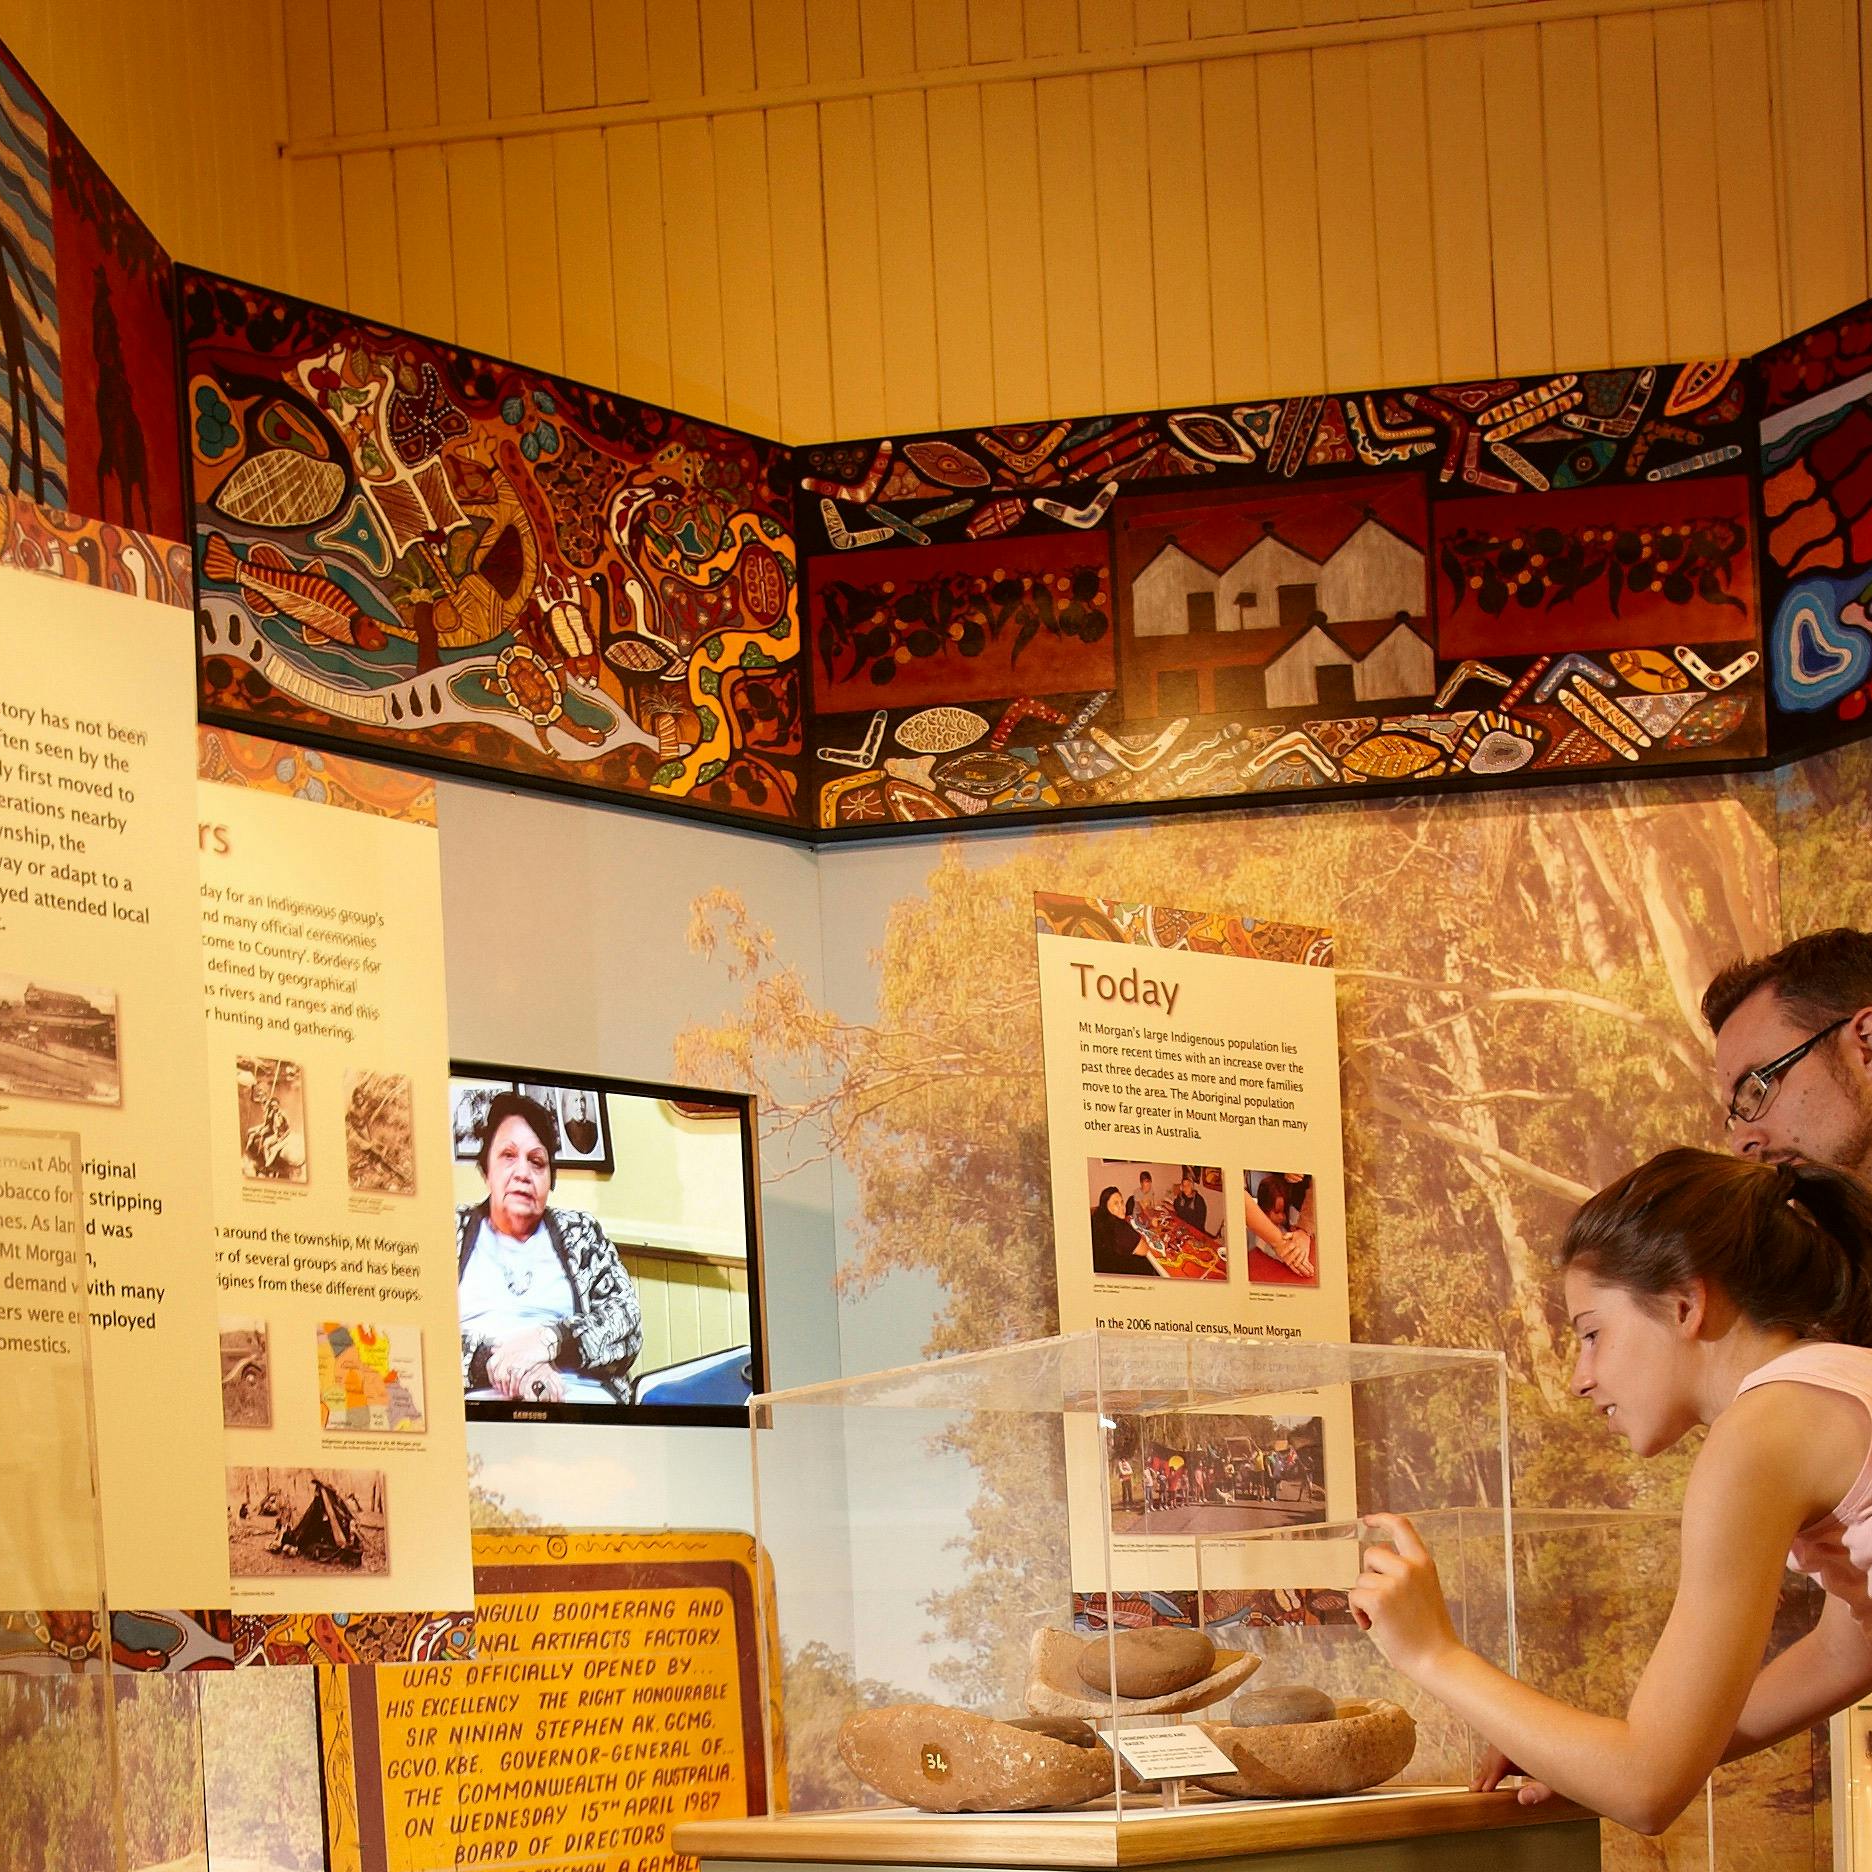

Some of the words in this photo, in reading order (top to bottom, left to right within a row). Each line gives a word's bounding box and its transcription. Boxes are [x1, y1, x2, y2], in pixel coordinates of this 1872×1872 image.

[41, 708, 69, 729] has
[76, 721, 101, 737] not
[108, 723, 145, 746] been
[36, 742, 73, 760] seen
[79, 746, 98, 769] by
[104, 753, 128, 772] the
[18, 764, 52, 787] first
[58, 777, 112, 798] moved
[119, 787, 134, 803] to
[1070, 963, 1179, 1016] Today
[1079, 1022, 1091, 1033] Mt
[1095, 1023, 1140, 1039] Morgan's
[1144, 1028, 1168, 1043] large
[1172, 1032, 1225, 1047] Indigenous
[1228, 1039, 1278, 1052] population
[1282, 1042, 1297, 1054] lies
[1081, 1040, 1089, 1052] in
[1093, 1045, 1119, 1055] more
[1122, 1048, 1152, 1058] recent
[1155, 1050, 1182, 1061] times
[1185, 1052, 1206, 1064] with
[1209, 1056, 1220, 1065] an
[1224, 1058, 1262, 1069] increase
[1266, 1062, 1286, 1071] over
[1289, 1062, 1303, 1073] the
[271, 1229, 290, 1243] the
[294, 1233, 352, 1251] township,
[356, 1236, 370, 1250] Mt
[375, 1238, 417, 1256] Morgan
[228, 1249, 241, 1263] of
[246, 1254, 289, 1267] several
[294, 1258, 336, 1273] groups
[341, 1260, 362, 1272] and
[367, 1261, 388, 1275] has
[392, 1264, 419, 1277] been
[1096, 1317, 1105, 1328] In
[1108, 1317, 1123, 1329] the
[1127, 1319, 1151, 1330] 2006
[1154, 1321, 1193, 1332] national
[1196, 1324, 1231, 1335] census,
[1234, 1324, 1263, 1335] Mount
[1266, 1325, 1301, 1339] Morgan
[553, 1600, 675, 1622] BOOMERANG
[688, 1600, 723, 1617] AND
[531, 1630, 631, 1651] ARTIFACTS
[403, 1666, 452, 1688] WAS
[466, 1663, 573, 1686] OFFICIALLY
[584, 1659, 656, 1679] OPENED
[386, 1700, 415, 1718] HIS
[422, 1694, 519, 1717] EXCELLENCY
[539, 1691, 568, 1710] THE
[578, 1689, 625, 1707] RIGHT
[633, 1684, 727, 1704] HONOURABLE
[407, 1727, 437, 1747] SIR
[449, 1723, 523, 1744] NINIAN
[536, 1717, 623, 1741] STEPHEN
[501, 1741, 690, 1771] GOVERNOR-GENERAL
[926, 1753, 948, 1773] 34
[405, 1787, 443, 1807] THE
[458, 1774, 617, 1804] COMMONWEALTH
[626, 1770, 646, 1790] OF
[405, 1817, 434, 1838] ON
[450, 1805, 567, 1834] WEDNESDAY
[624, 1796, 673, 1817] APRIL
[684, 1793, 720, 1812] 1987
[455, 1840, 518, 1868] BOARD
[529, 1837, 552, 1856] OF
[564, 1824, 665, 1853] DIRECTORS
